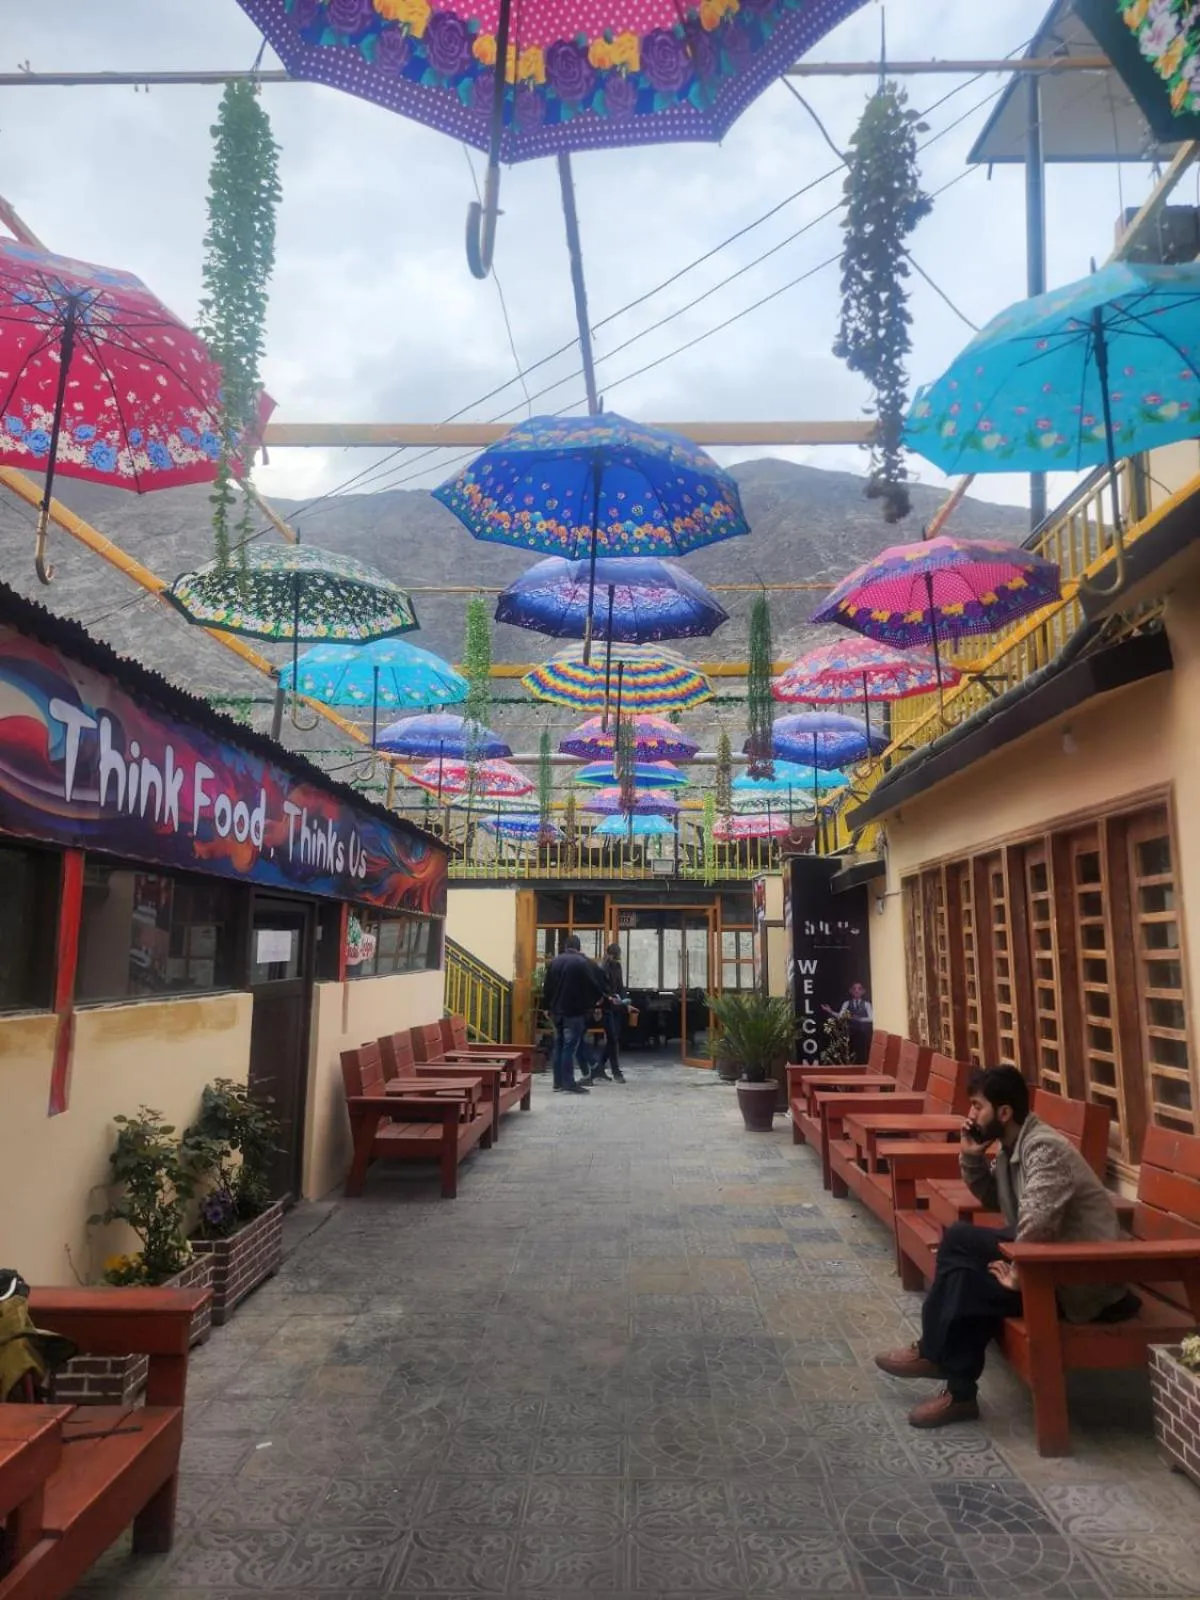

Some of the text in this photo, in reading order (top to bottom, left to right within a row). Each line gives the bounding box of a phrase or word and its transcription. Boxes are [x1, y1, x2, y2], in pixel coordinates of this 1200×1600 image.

[49, 698, 184, 832] Think
[283, 800, 345, 874] Thinks
[349, 831, 368, 878] Us
